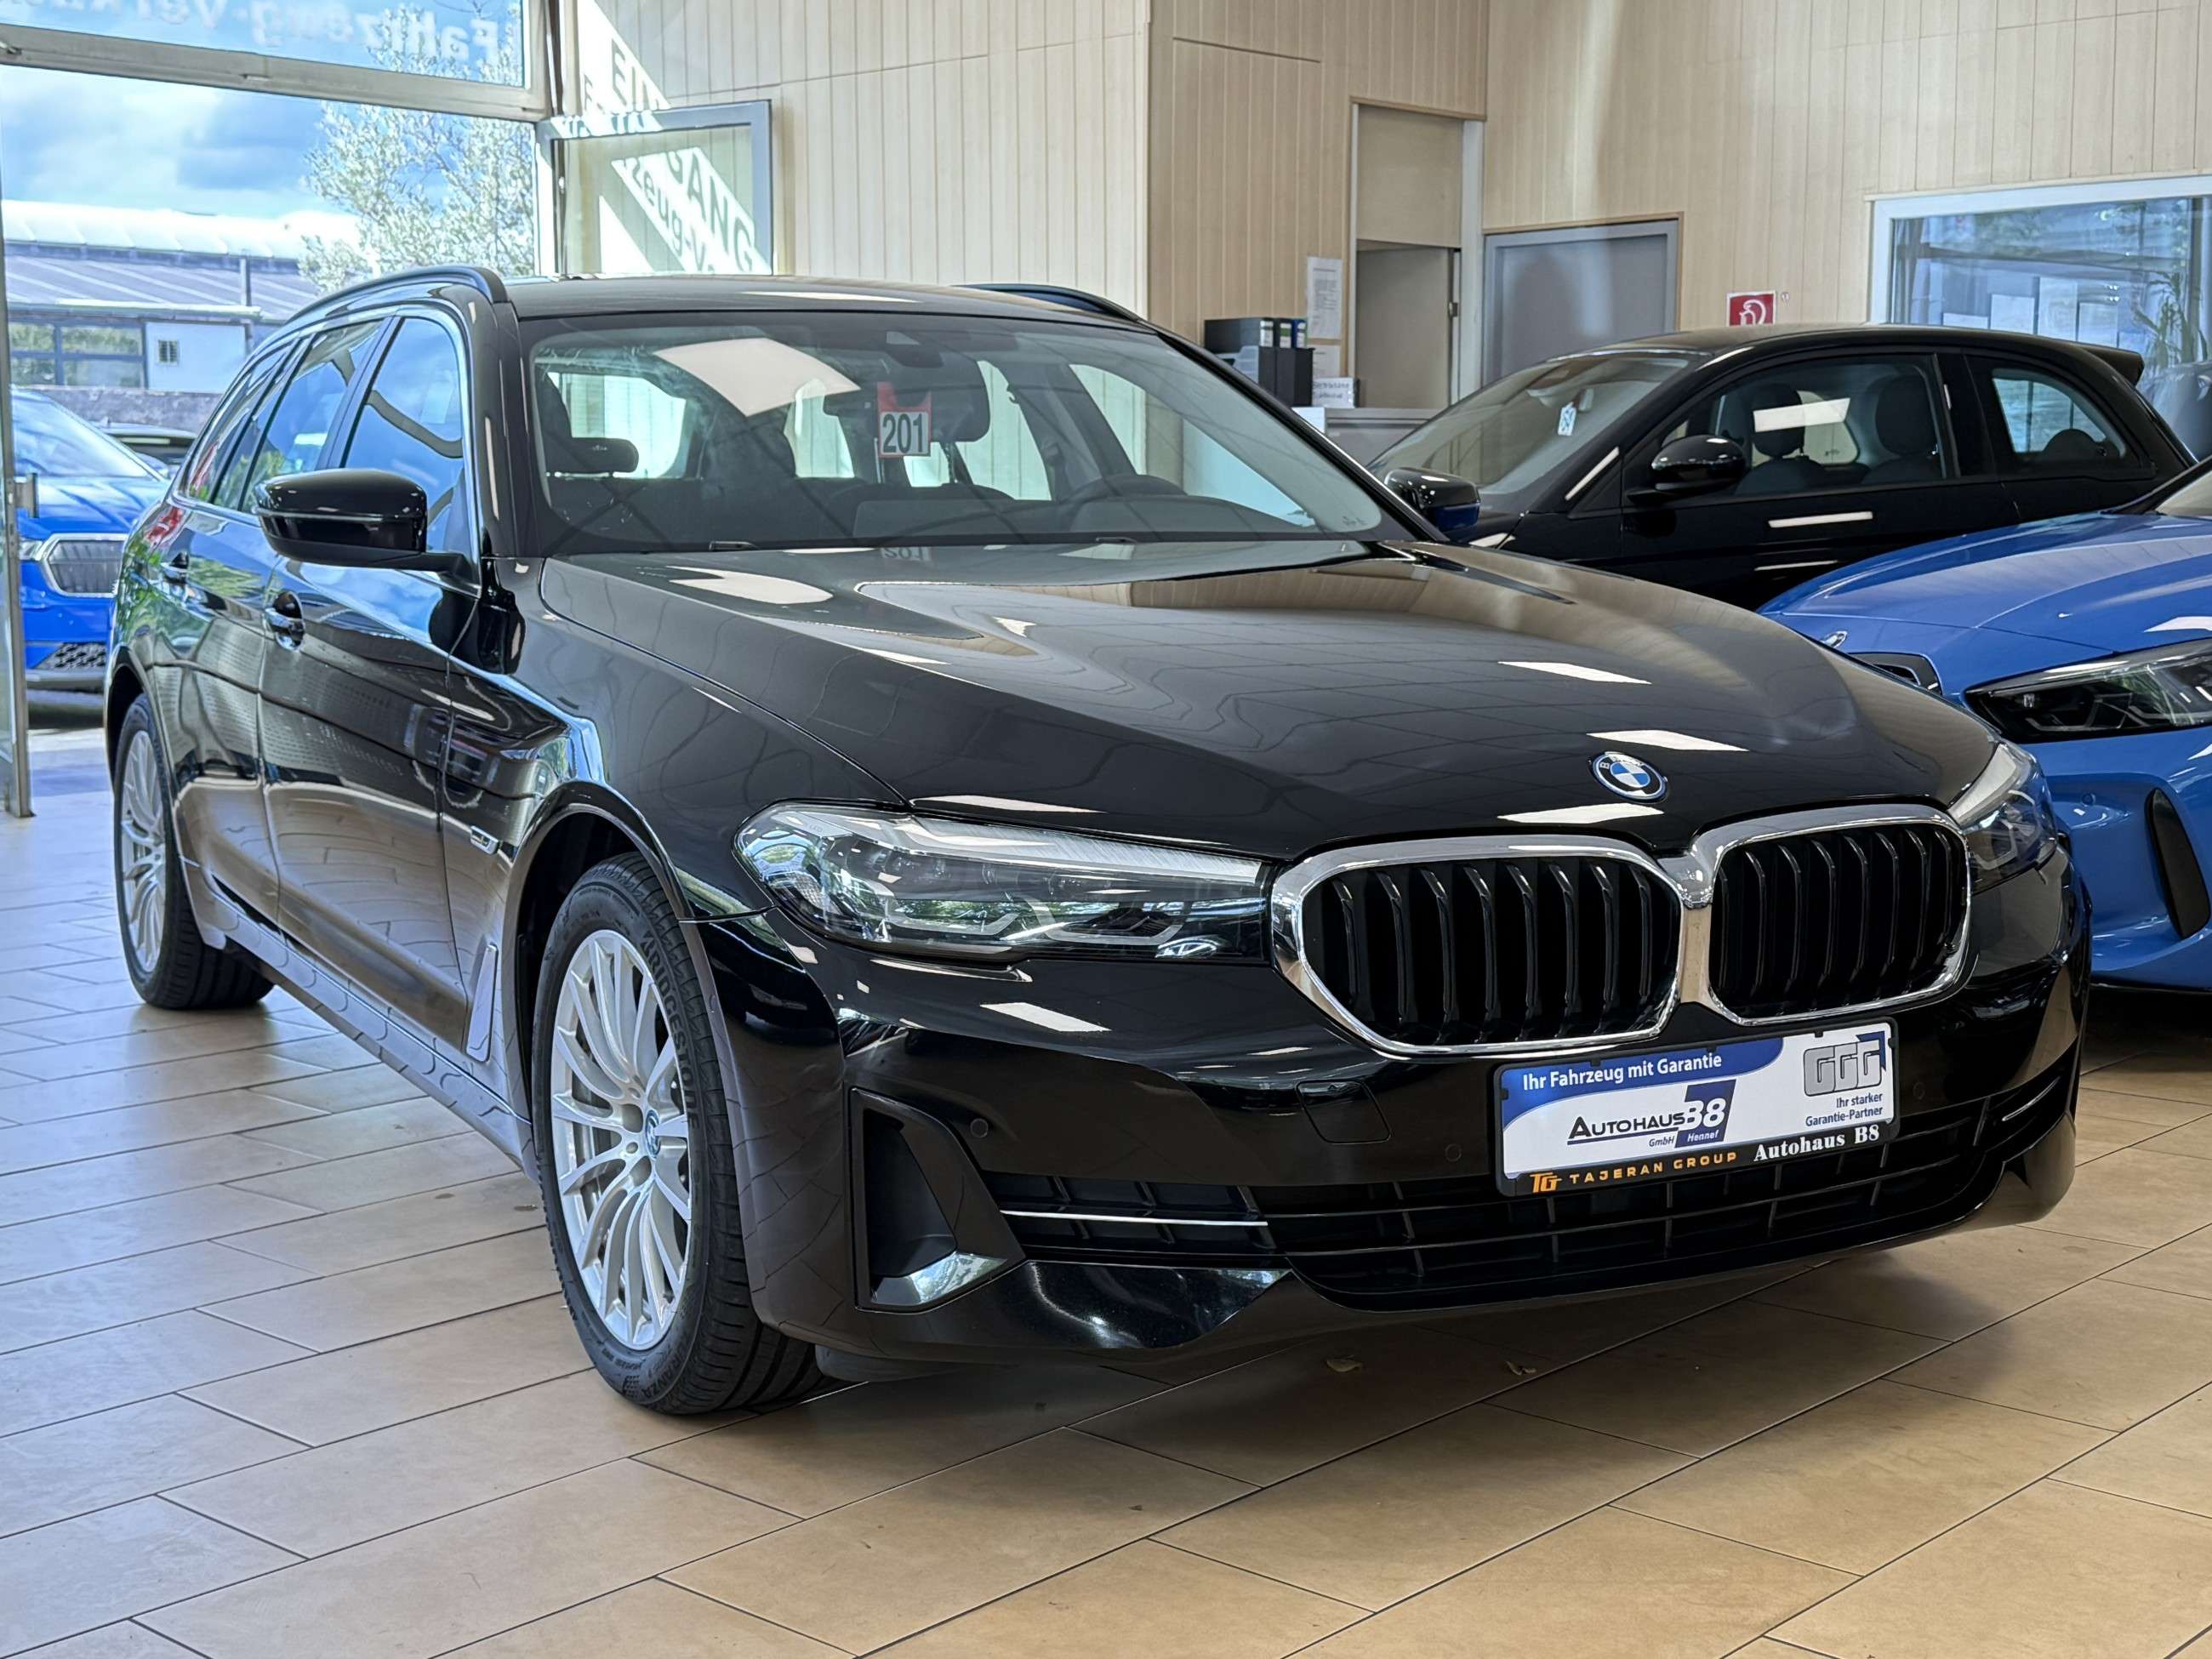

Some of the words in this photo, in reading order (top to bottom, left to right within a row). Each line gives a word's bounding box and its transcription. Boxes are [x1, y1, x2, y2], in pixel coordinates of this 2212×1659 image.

[882, 413, 923, 454] 201
[1523, 1074, 1546, 1091] Ihr
[1550, 1069, 1624, 1087] Fahrzeug
[1628, 1060, 1654, 1079] mit
[1657, 1052, 1722, 1075] Garantie
[1836, 1097, 1849, 1108] Ihr
[1851, 1093, 1883, 1106] starker
[1805, 1106, 1883, 1126] Garantie-Partner
[1649, 1136, 1675, 1148] GmbH
[1687, 1130, 1719, 1142] Hennef
[1753, 1133, 1845, 1162] Autohaus
[1854, 1124, 1880, 1144] B8
[1570, 1161, 1664, 1184] TAJERAN
[1673, 1151, 1737, 1170] GROUP
